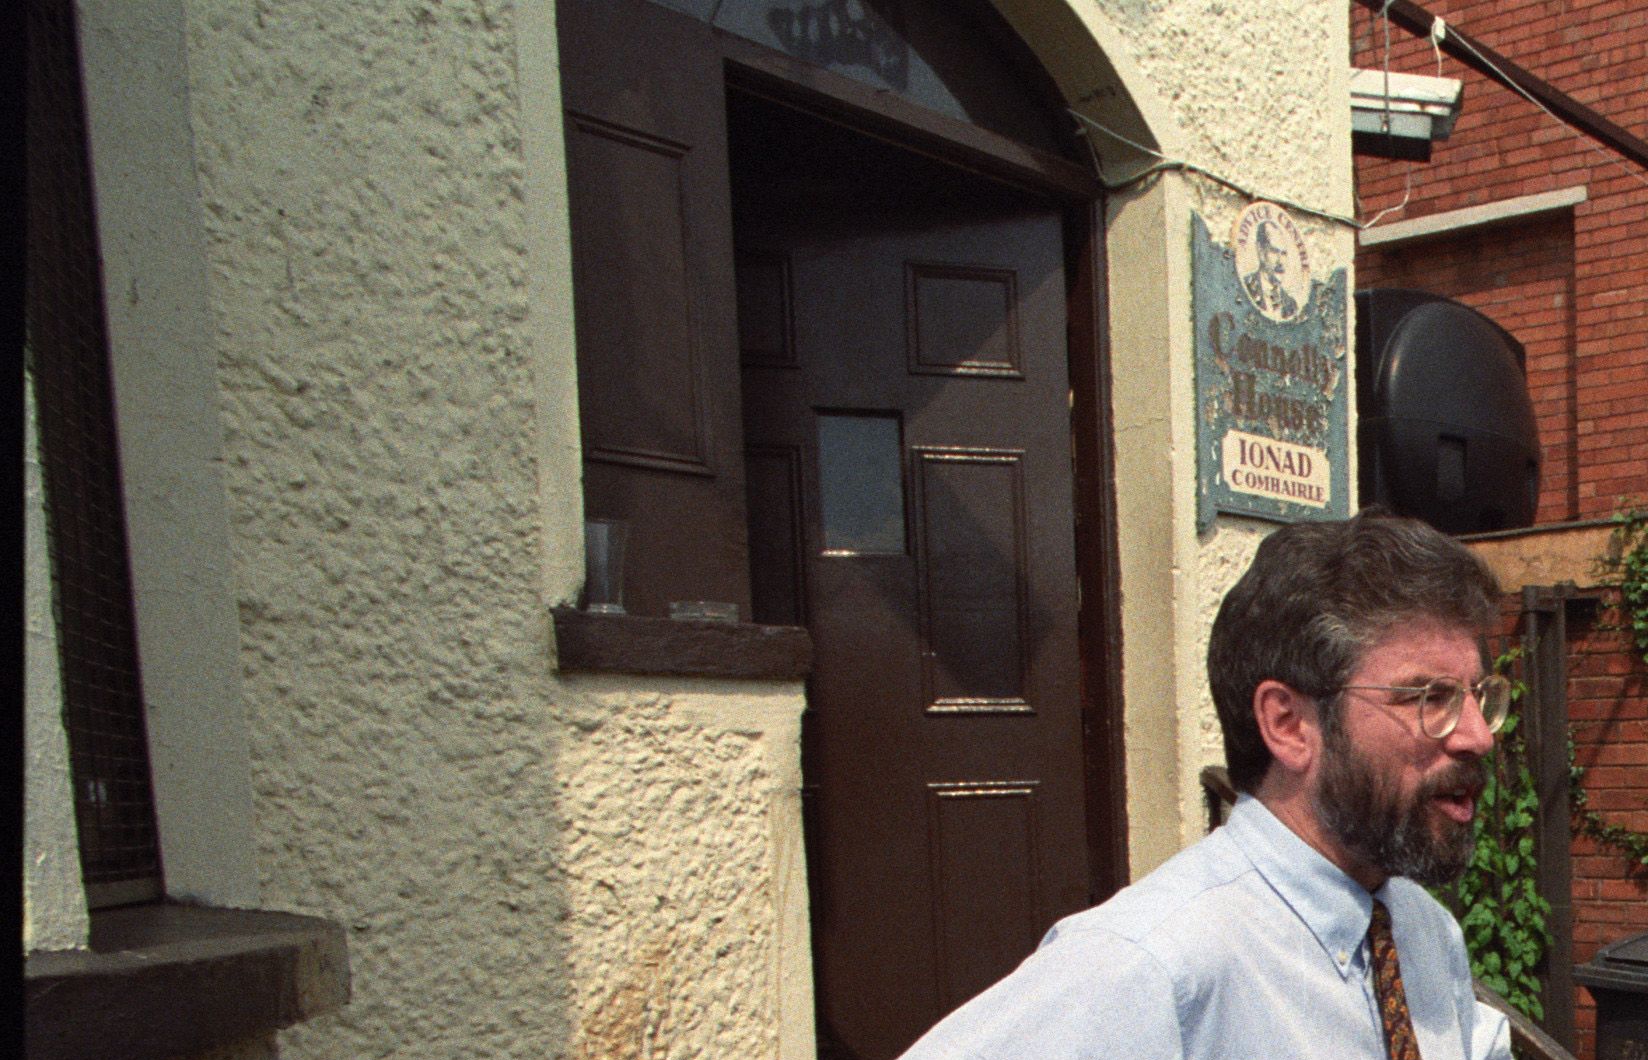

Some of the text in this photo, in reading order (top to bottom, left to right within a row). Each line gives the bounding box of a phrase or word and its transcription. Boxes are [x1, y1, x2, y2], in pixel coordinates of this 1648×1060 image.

[1237, 205, 1272, 247] ADVICE
[1239, 439, 1314, 479] IONAD
[1232, 469, 1326, 503] COMHAIRLE
